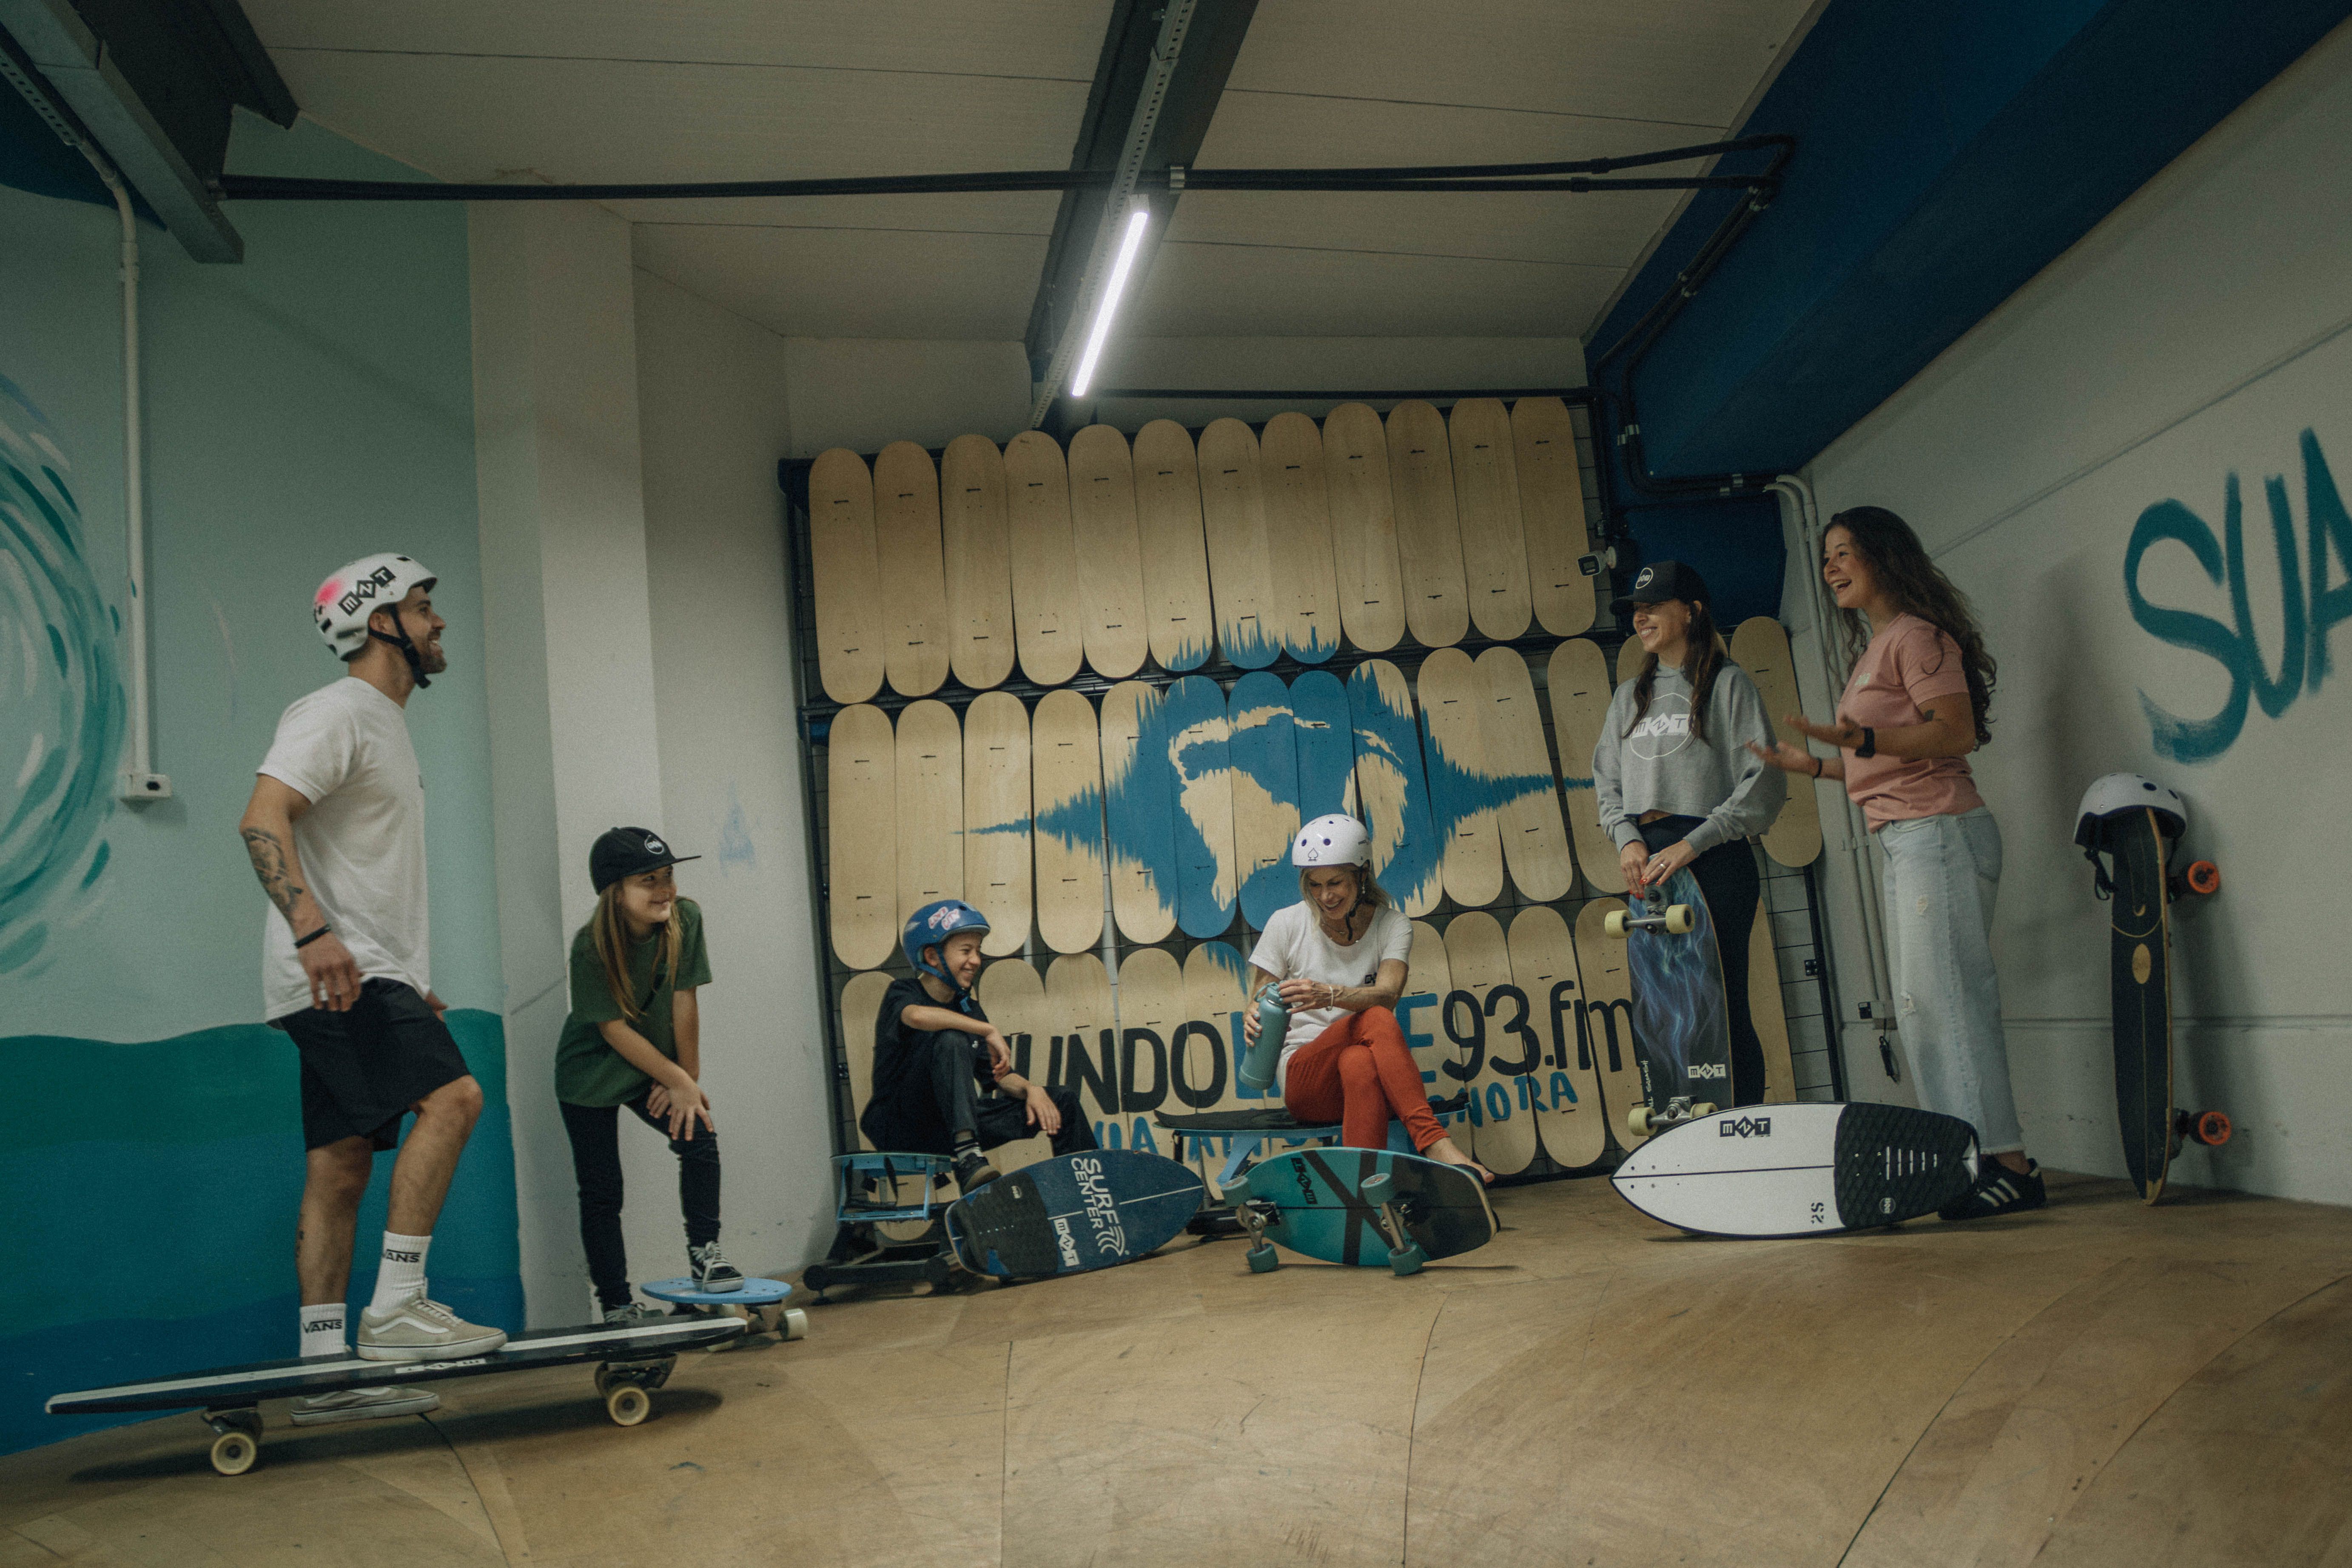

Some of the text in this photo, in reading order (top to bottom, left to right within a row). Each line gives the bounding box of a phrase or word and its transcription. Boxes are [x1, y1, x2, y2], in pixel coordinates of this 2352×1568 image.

[1071, 1157, 1104, 1229] CENTER
[1083, 1158, 1120, 1224] SURF
[302, 1319, 343, 1334] VANS
